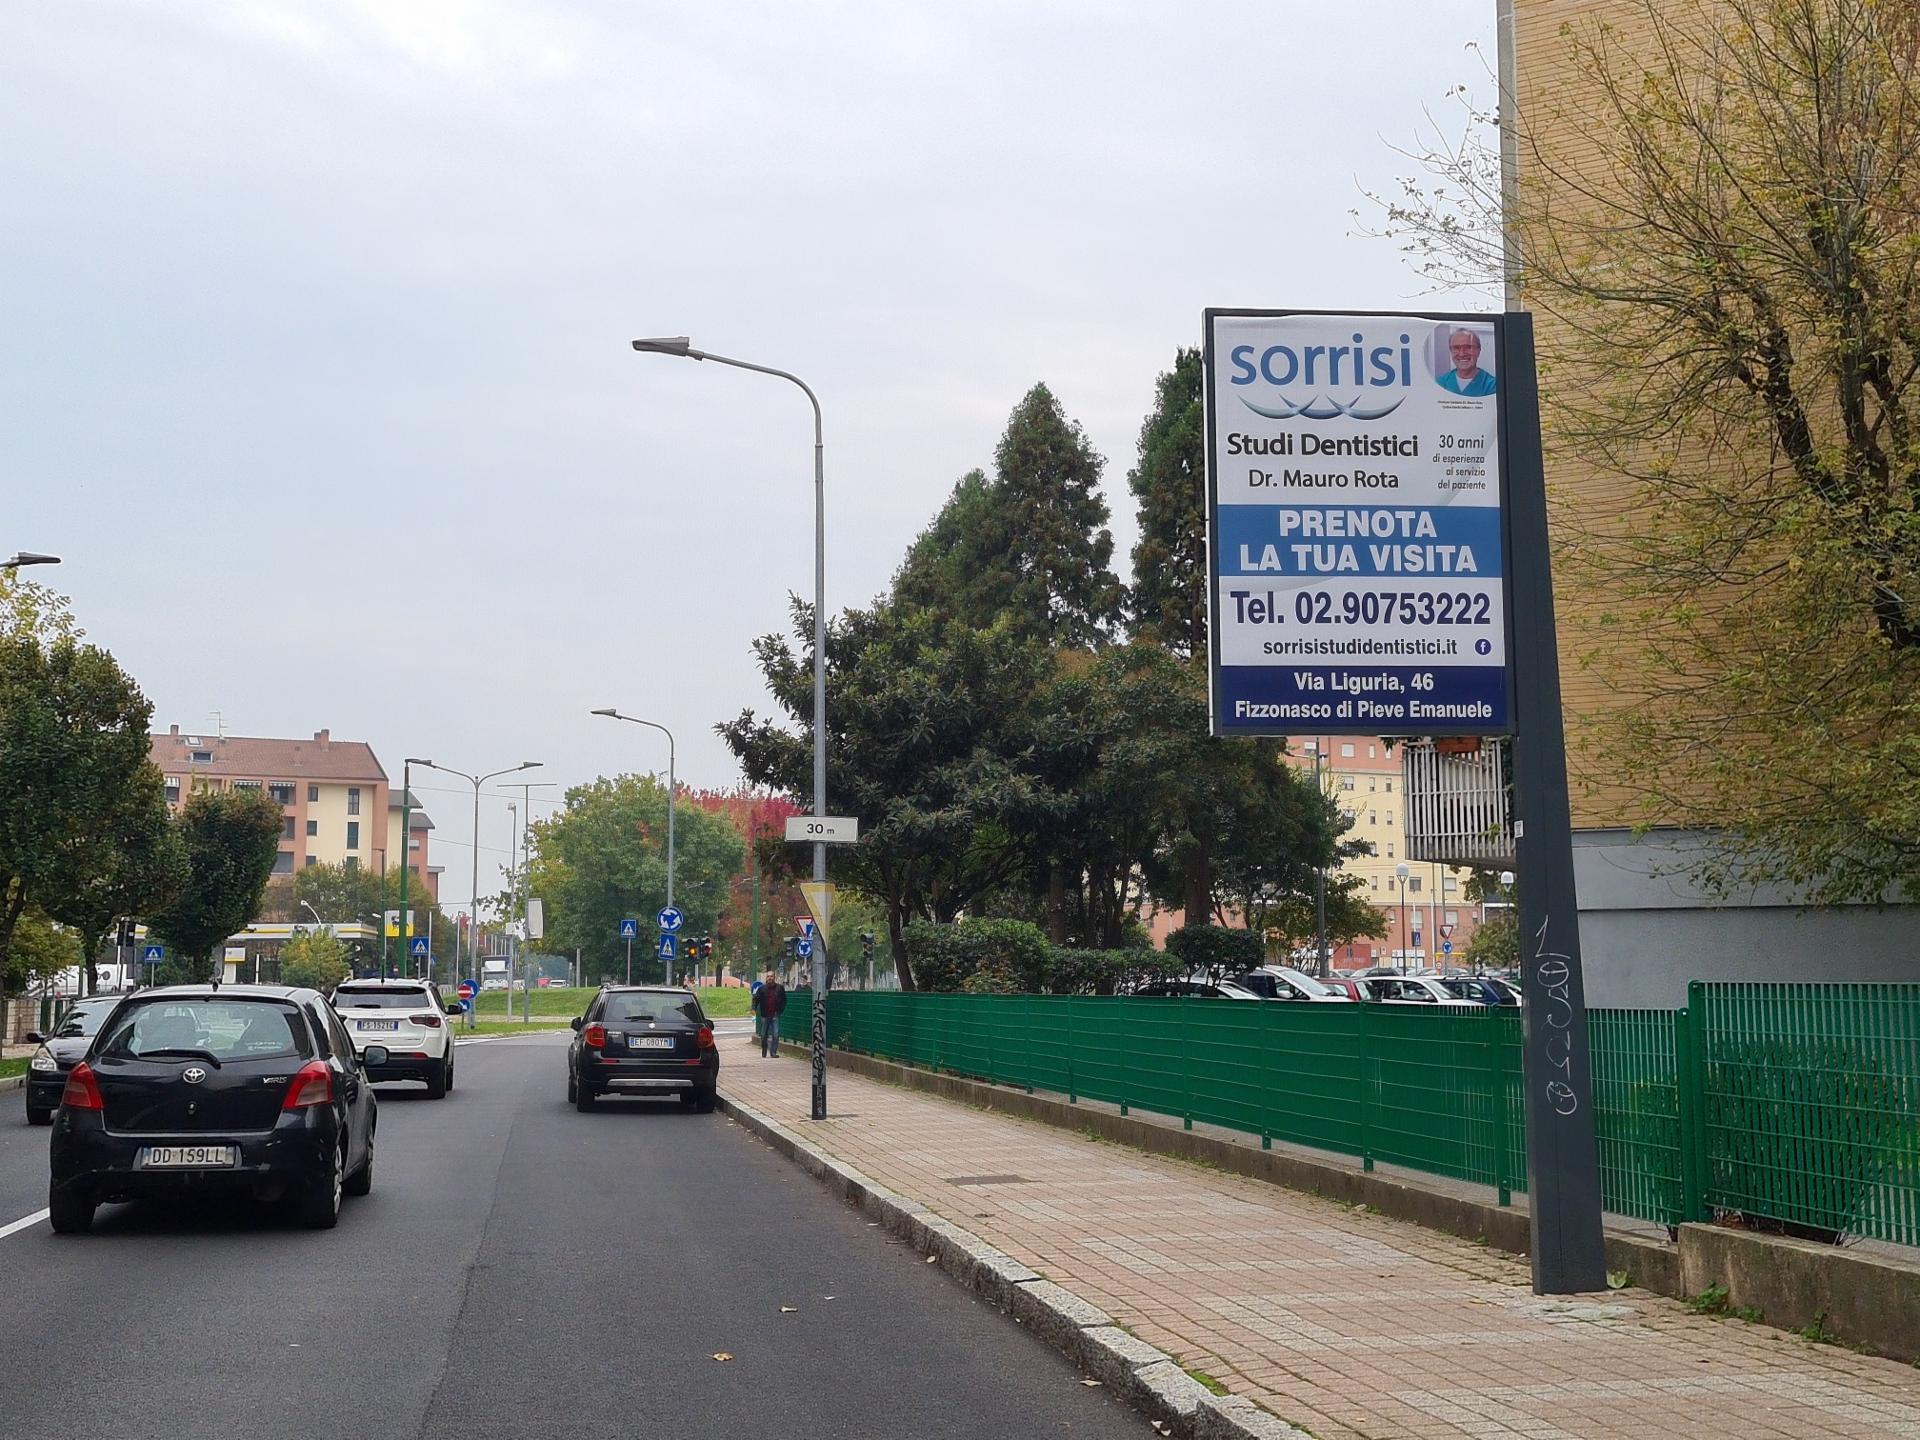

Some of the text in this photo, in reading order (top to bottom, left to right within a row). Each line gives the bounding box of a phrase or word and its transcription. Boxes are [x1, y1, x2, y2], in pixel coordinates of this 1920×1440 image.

[1230, 333, 1411, 386] sorrisi
[1227, 432, 1419, 457] Studi Dentistici
[1439, 435, 1484, 449] 30 anni
[1432, 453, 1485, 465] di esperienza
[1249, 469, 1399, 488] Dr. Mauro Rota
[1446, 467, 1486, 477] al servizio
[1437, 480, 1486, 491] del paziente
[1279, 510, 1438, 538] PRENOTA
[1239, 544, 1478, 573] LA TUA VISITA
[1230, 591, 1491, 625] Tel. 02.90753222
[1263, 639, 1457, 655] sorrisistudidentistici.it
[1294, 672, 1434, 695] Via Liguria, 46
[1235, 700, 1492, 718] Fizzonasco di Pieve Emanuele
[806, 823, 824, 834] 30
[152, 1148, 223, 1164] DD 159LL
